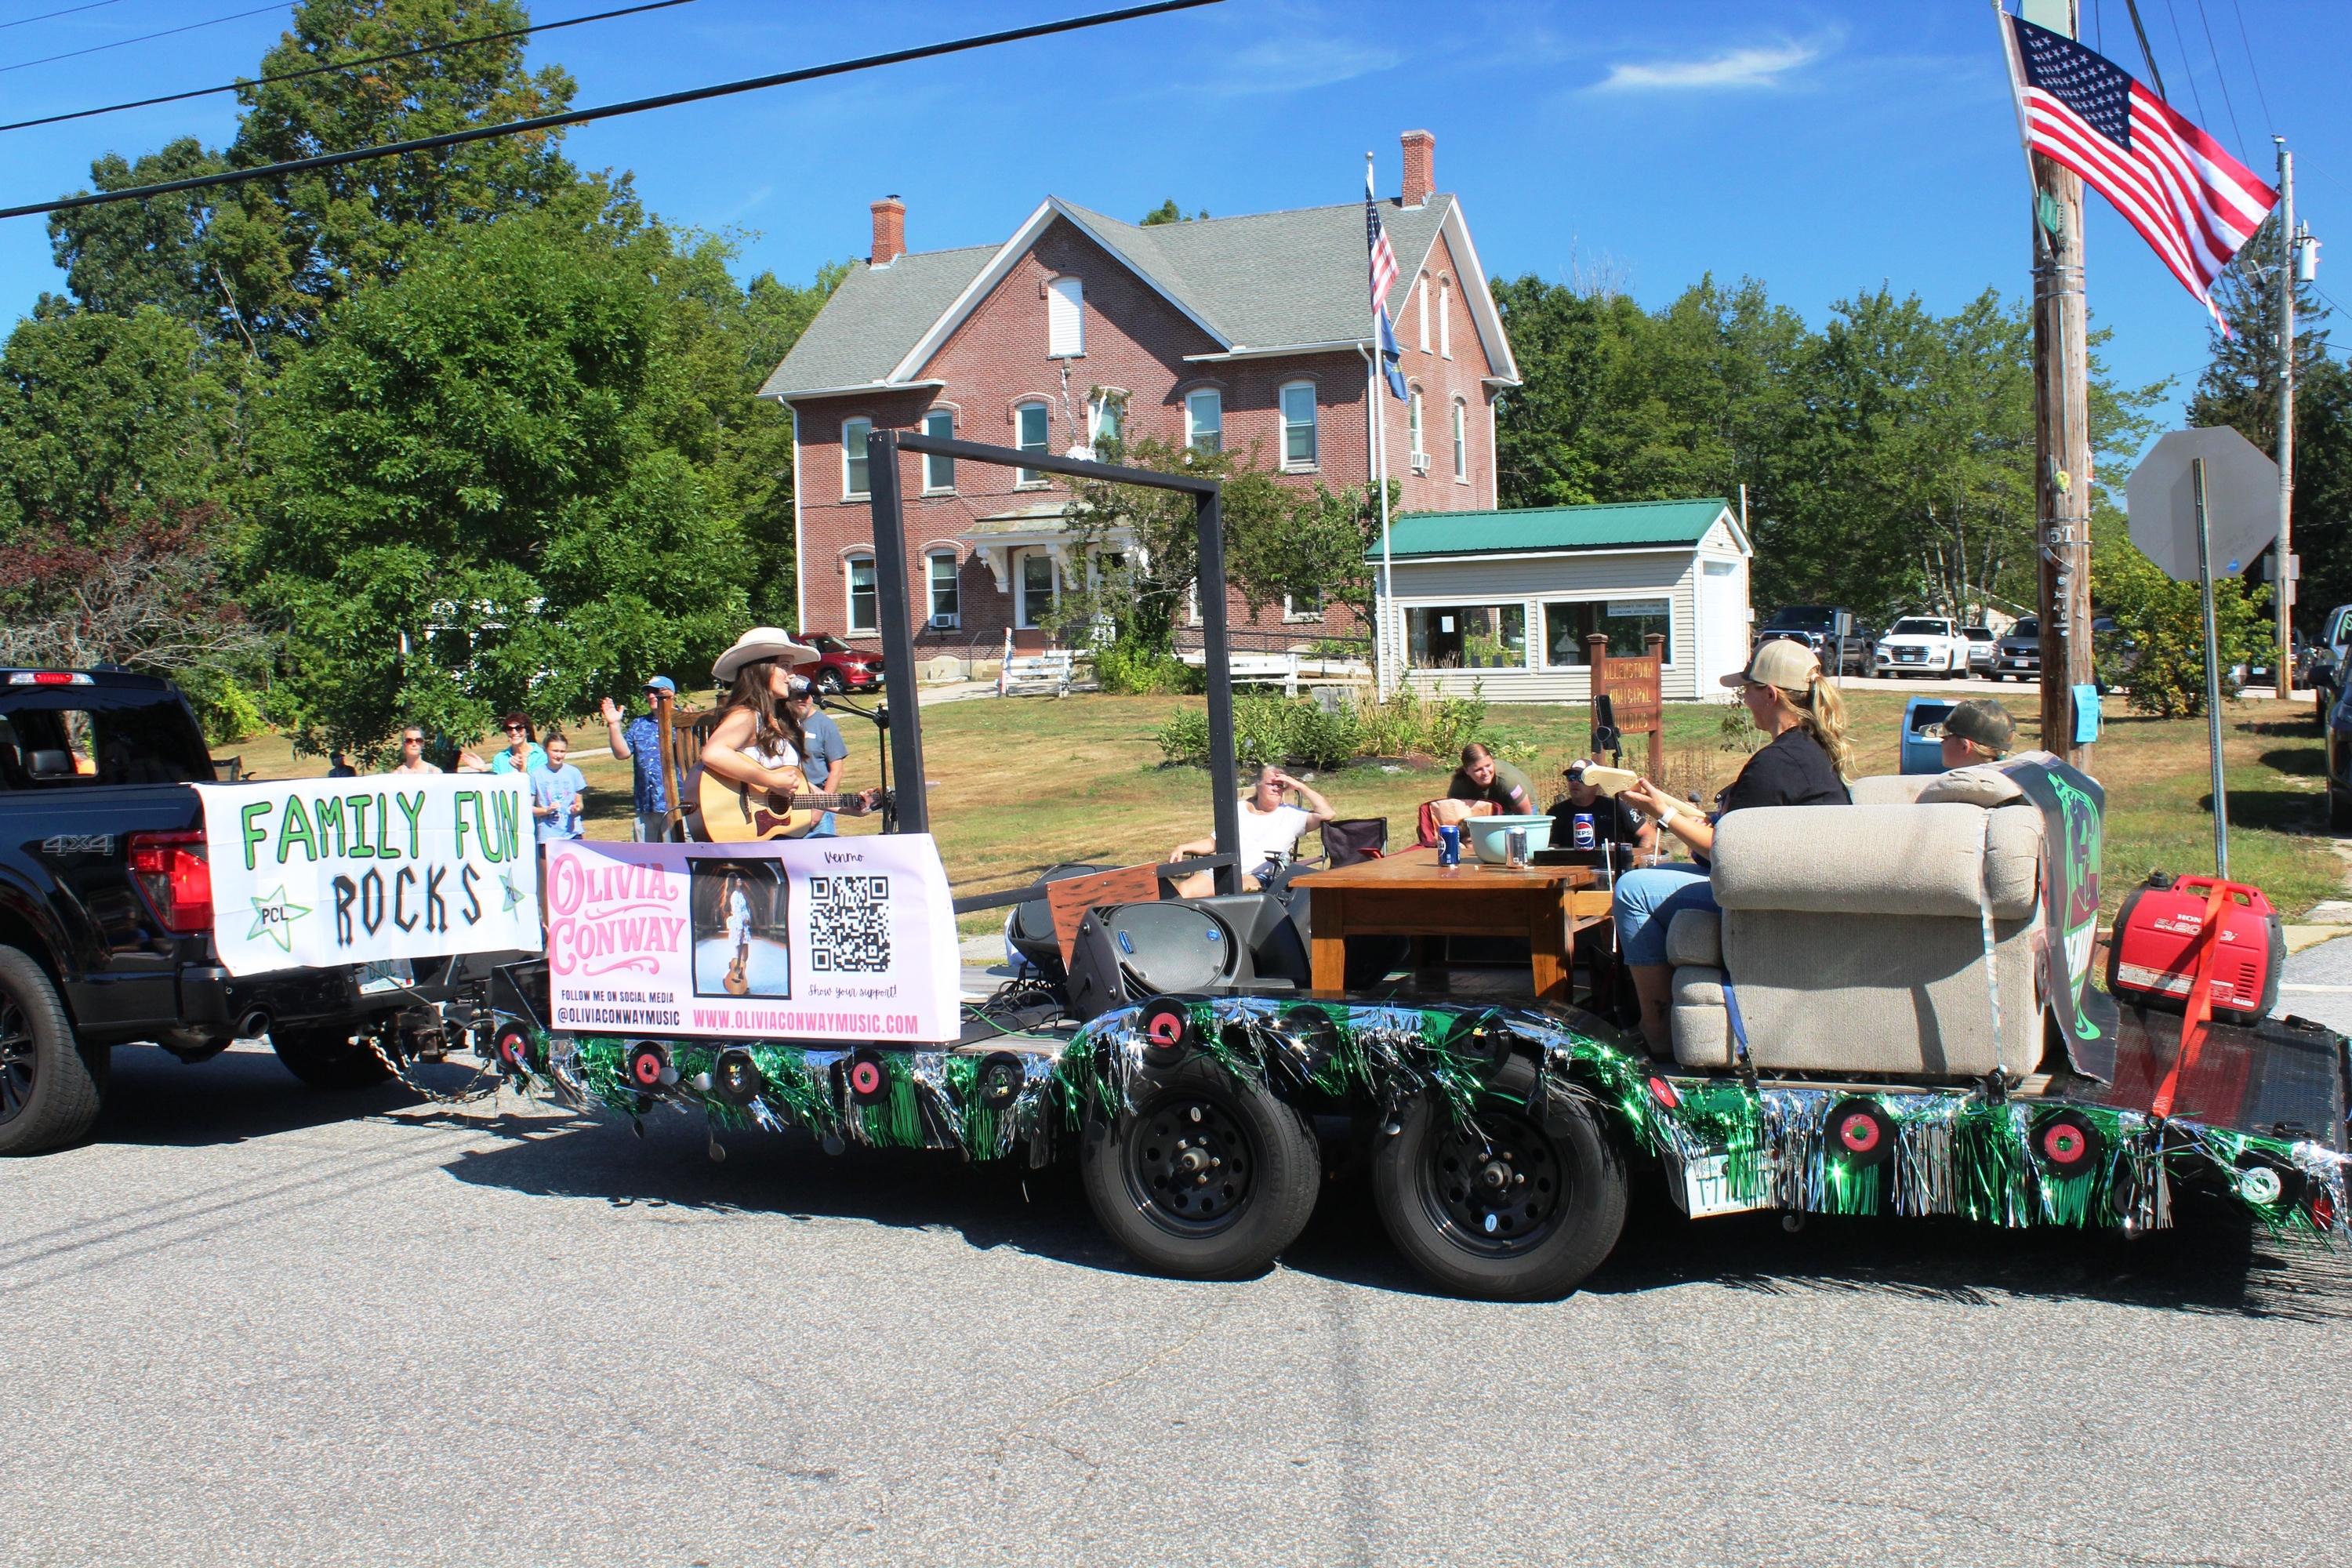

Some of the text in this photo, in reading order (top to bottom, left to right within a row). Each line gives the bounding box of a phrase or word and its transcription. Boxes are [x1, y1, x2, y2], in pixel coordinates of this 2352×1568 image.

[1604, 662, 1653, 680] ALLENSTOWN
[1615, 712, 1648, 730] UILDING
[242, 790, 518, 870] FAMILY FUN
[824, 851, 864, 864] Venmo
[549, 852, 679, 916] OLIVIA
[332, 862, 482, 948] ROCKS
[262, 906, 289, 924] PCL
[2176, 913, 2202, 924] HON
[549, 916, 687, 976] CONWAY
[561, 989, 674, 1004] FOLLOW ME ON SOCIAL MEDIA
[808, 984, 897, 1000] Show your support!
[557, 1007, 680, 1026] @OLIVIACONWAYMUSIC
[693, 1009, 918, 1034] WWW.OLIVIACONWAYMUSIC.COM
